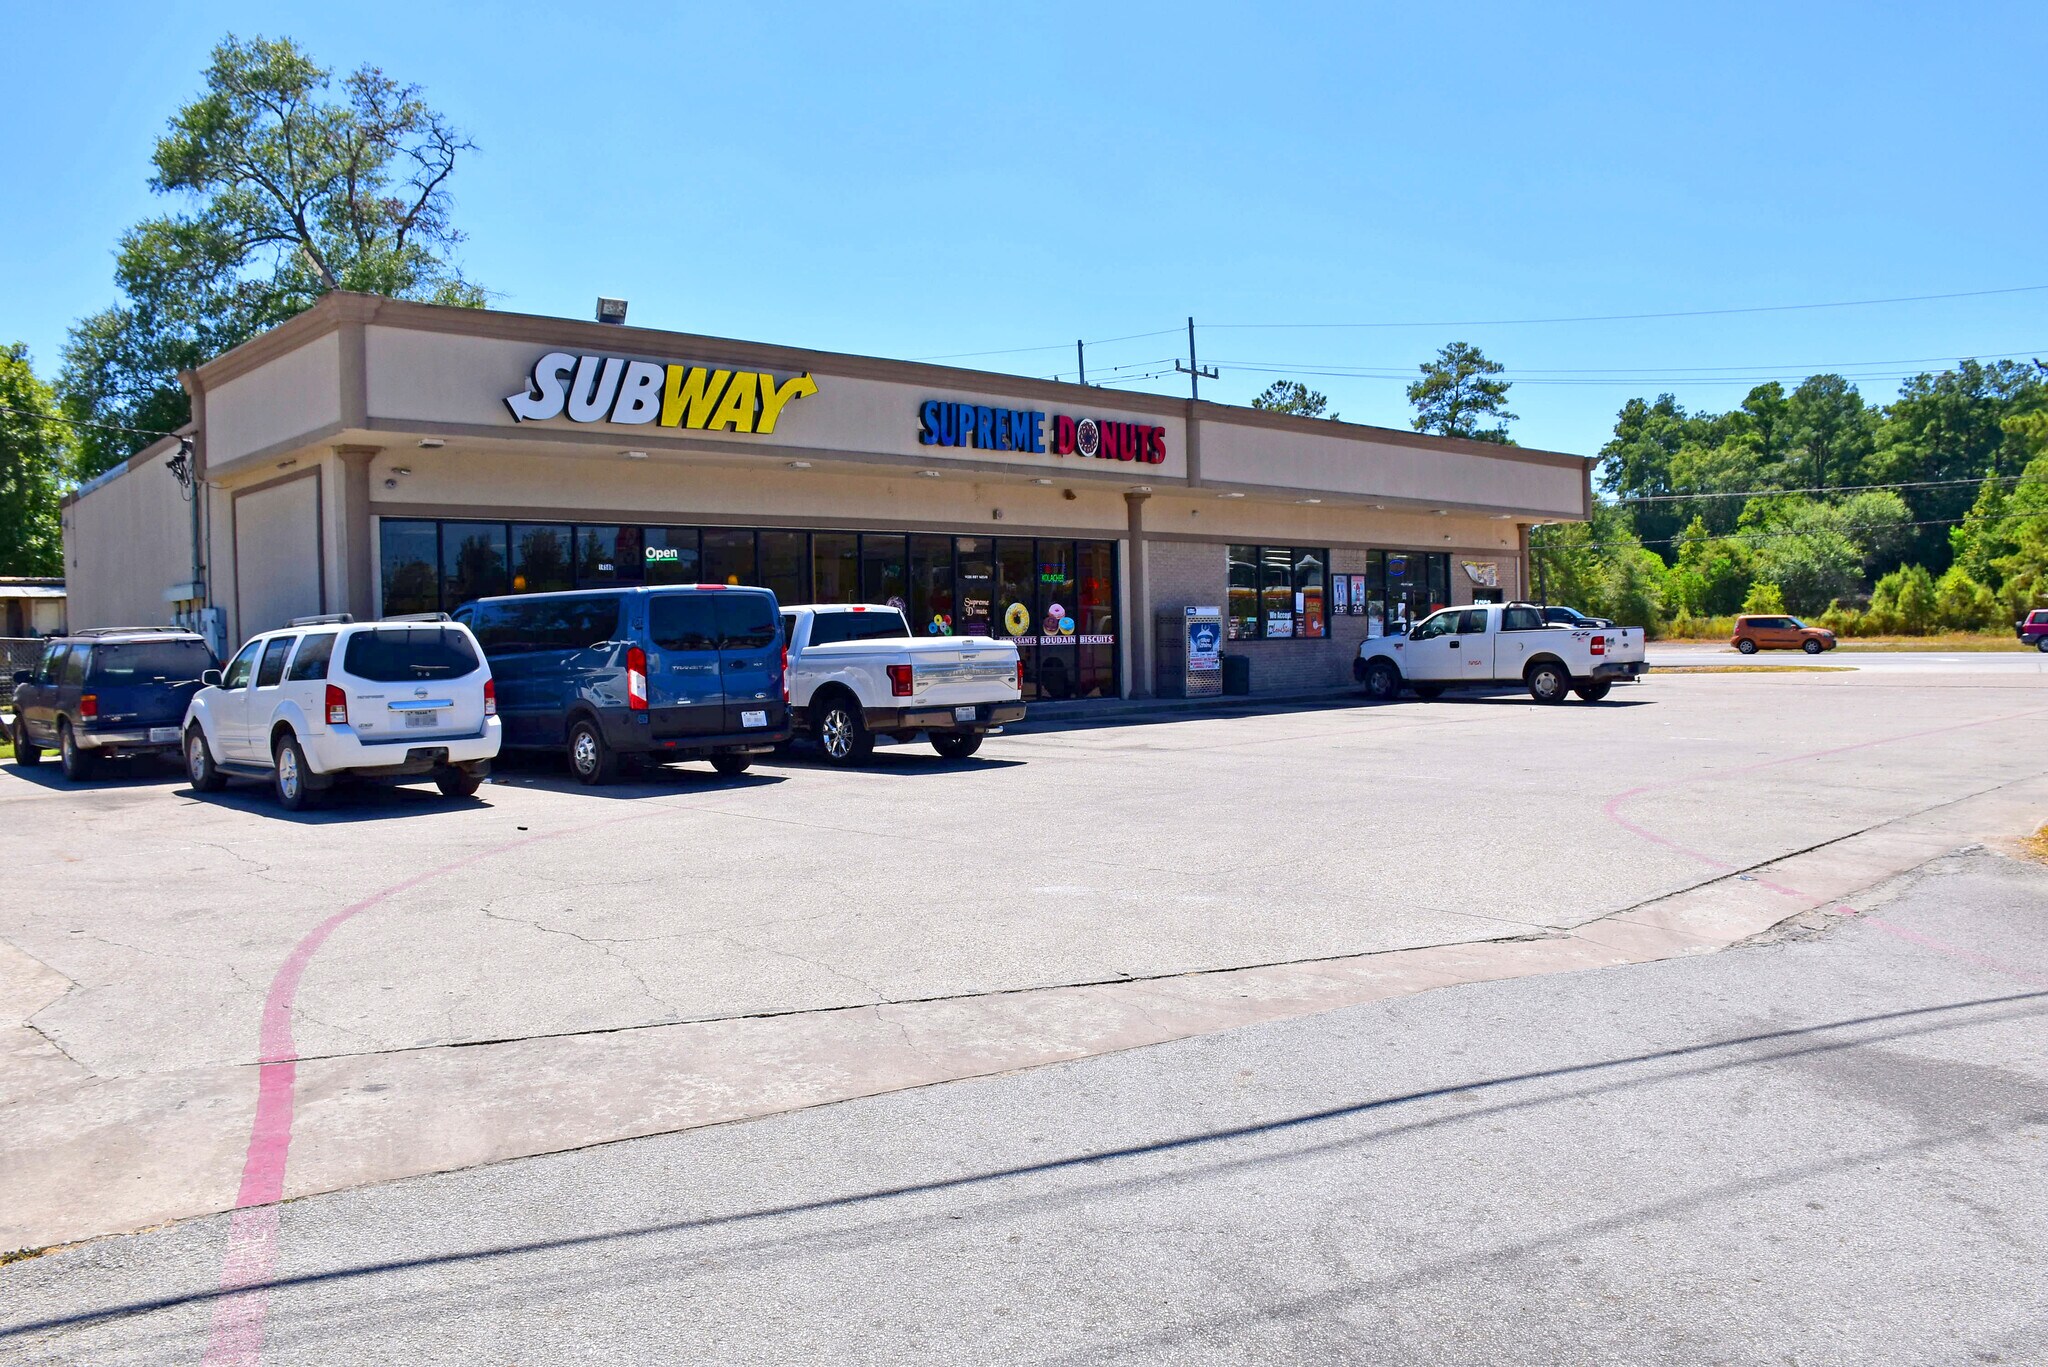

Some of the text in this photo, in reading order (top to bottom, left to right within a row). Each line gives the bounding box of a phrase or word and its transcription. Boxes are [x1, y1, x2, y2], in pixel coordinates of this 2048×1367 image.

[506, 352, 819, 435] SUBWAY
[920, 400, 1166, 464] SUPREME DONUTS
[645, 547, 678, 561] Open
[964, 597, 990, 608] Supreme
[1269, 611, 1292, 620] We Accept
[1040, 635, 1076, 645] BOUDAIN
[1079, 634, 1113, 644] BISCUITS
